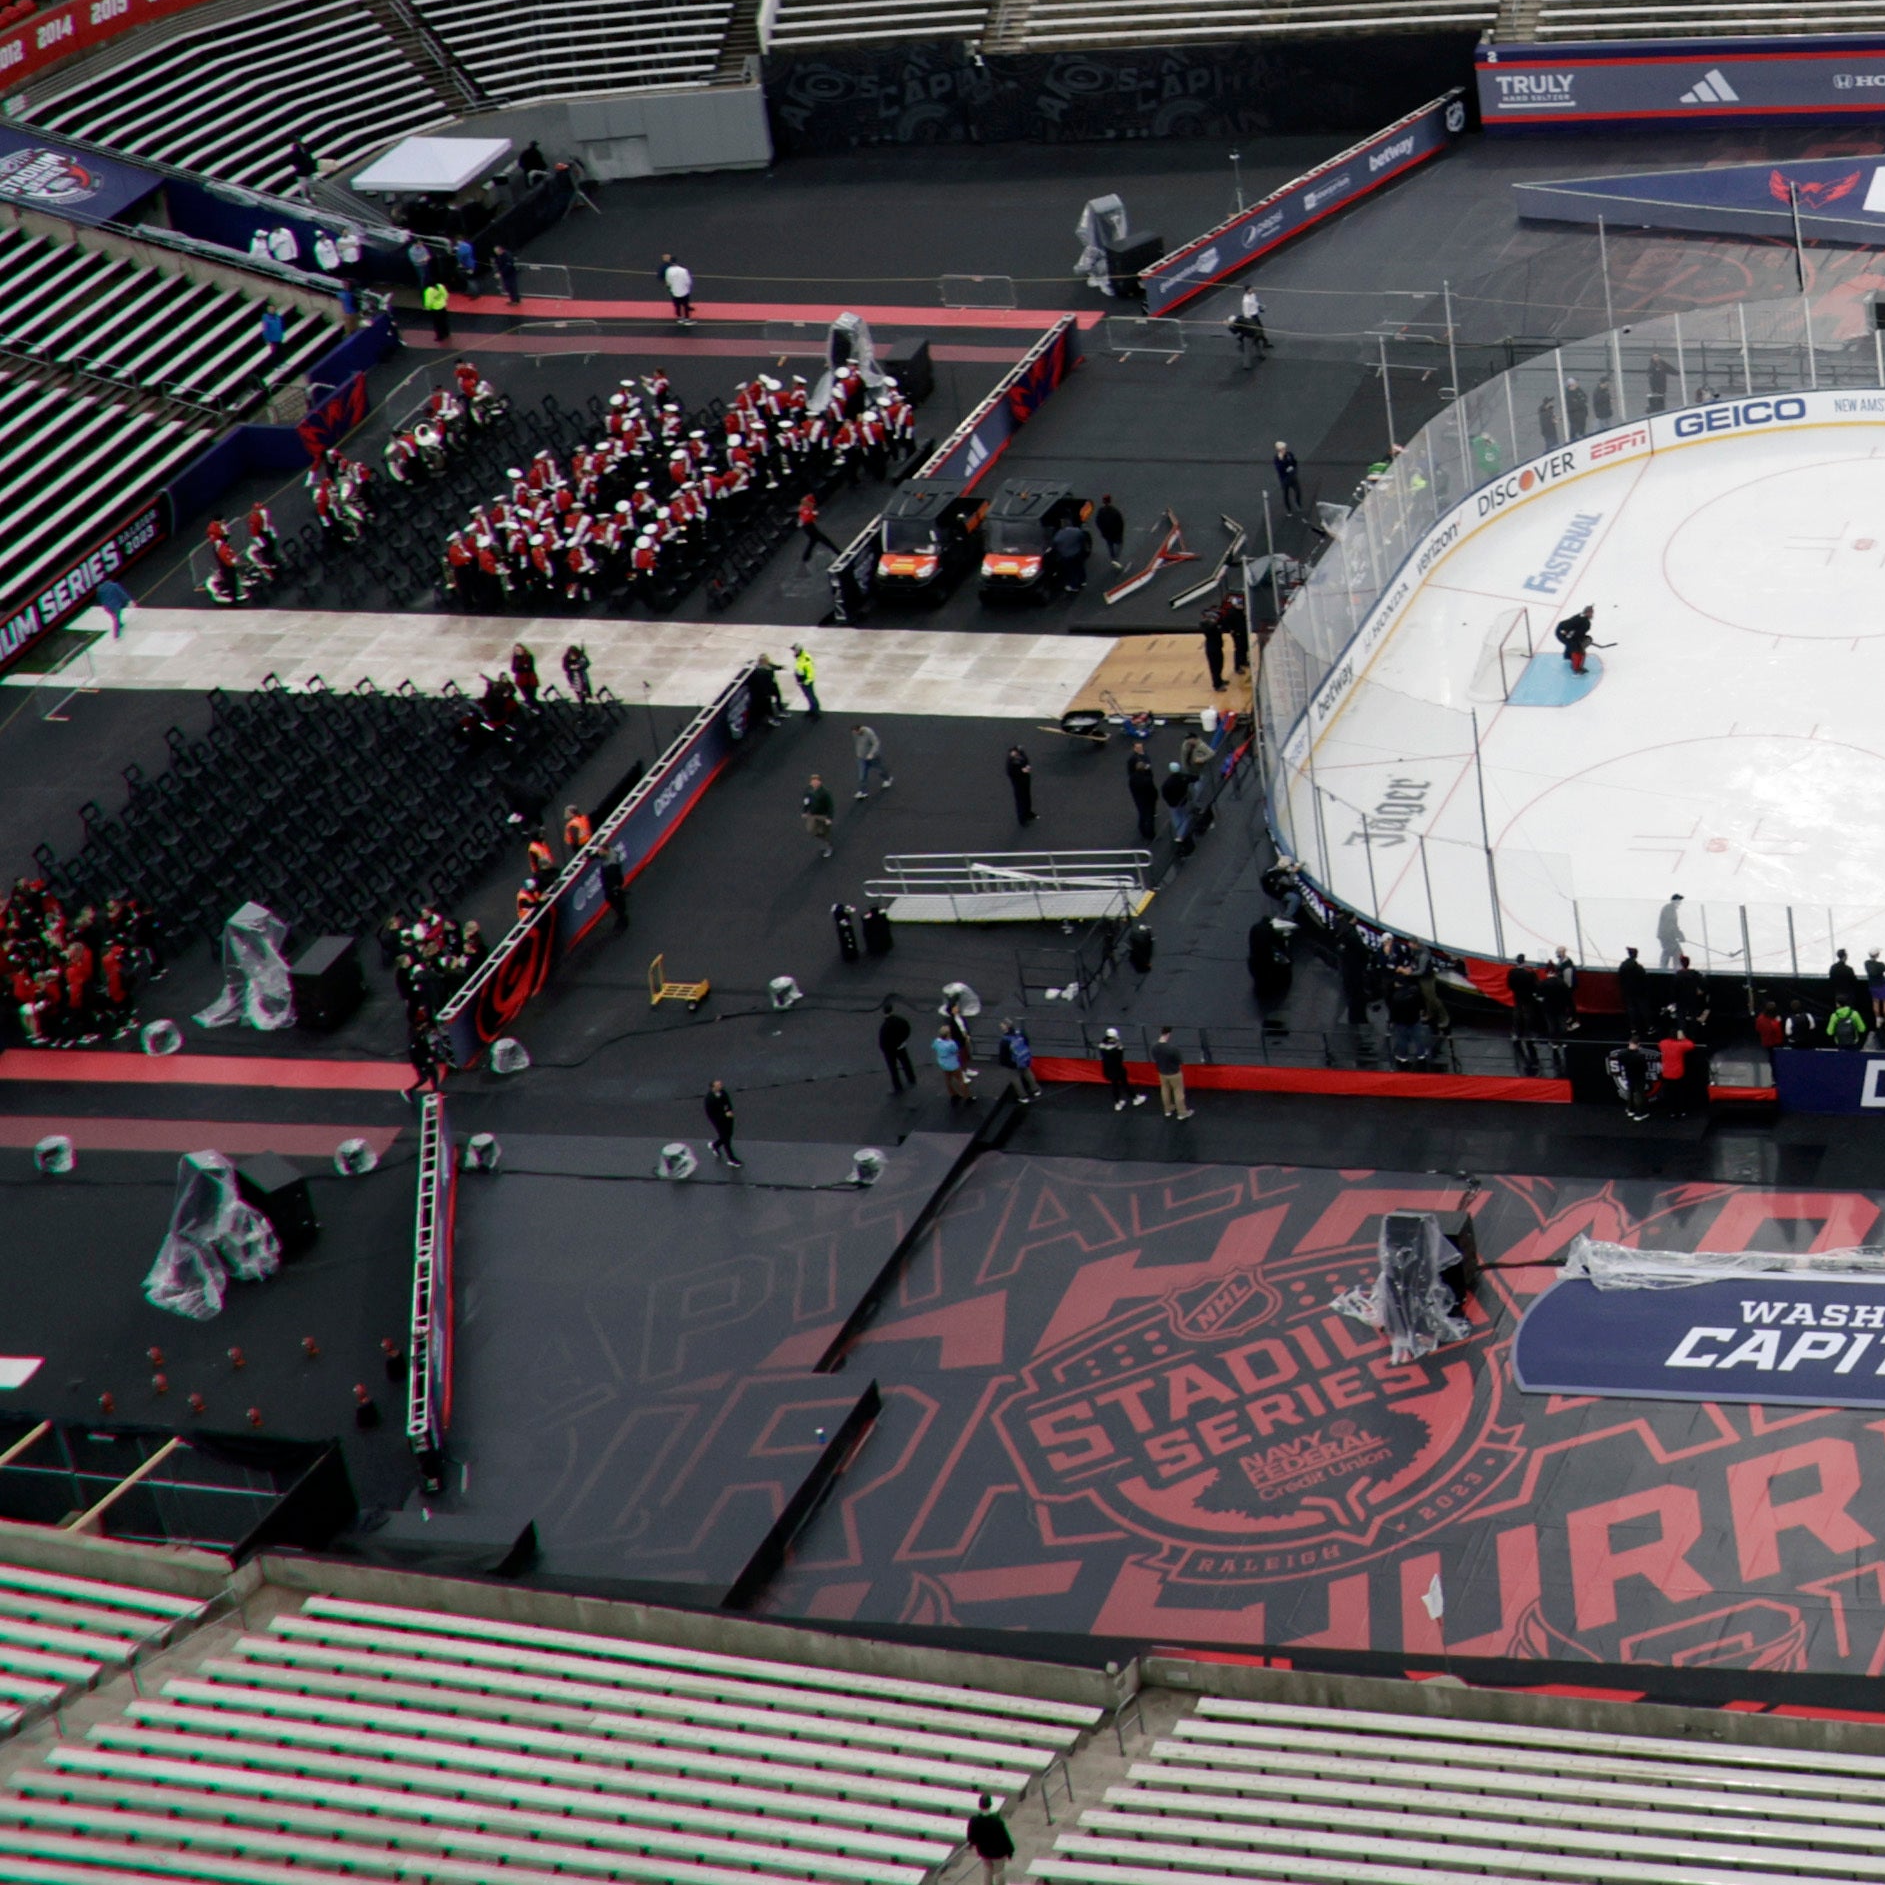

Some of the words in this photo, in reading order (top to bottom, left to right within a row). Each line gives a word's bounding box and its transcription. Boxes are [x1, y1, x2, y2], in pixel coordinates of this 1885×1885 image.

[36, 14, 73, 49] 2014
[1488, 51, 1497, 62] 2
[1496, 74, 1574, 96] TRULY
[1369, 136, 1415, 171] betway
[1675, 397, 1806, 438] GEICO
[1834, 399, 1858, 412] NEW
[1590, 429, 1646, 461] ESPN
[1477, 451, 1576, 518] DISCOVER
[1416, 520, 1460, 575] verizon
[1523, 510, 1602, 595] FASTENAL
[37, 540, 122, 625] SERIES
[1316, 657, 1355, 721] betway
[1195, 1281, 1249, 1331] NHL
[1143, 1355, 1430, 1480] SERIES
[1238, 1427, 1325, 1471] NAVY
[1248, 1428, 1384, 1486] FEDERAL
[1257, 1472, 1327, 1503] Credit
[1330, 1446, 1393, 1478] Union
[1195, 1543, 1342, 1575] RALEIGH
[1416, 1470, 1484, 1522] 2023
